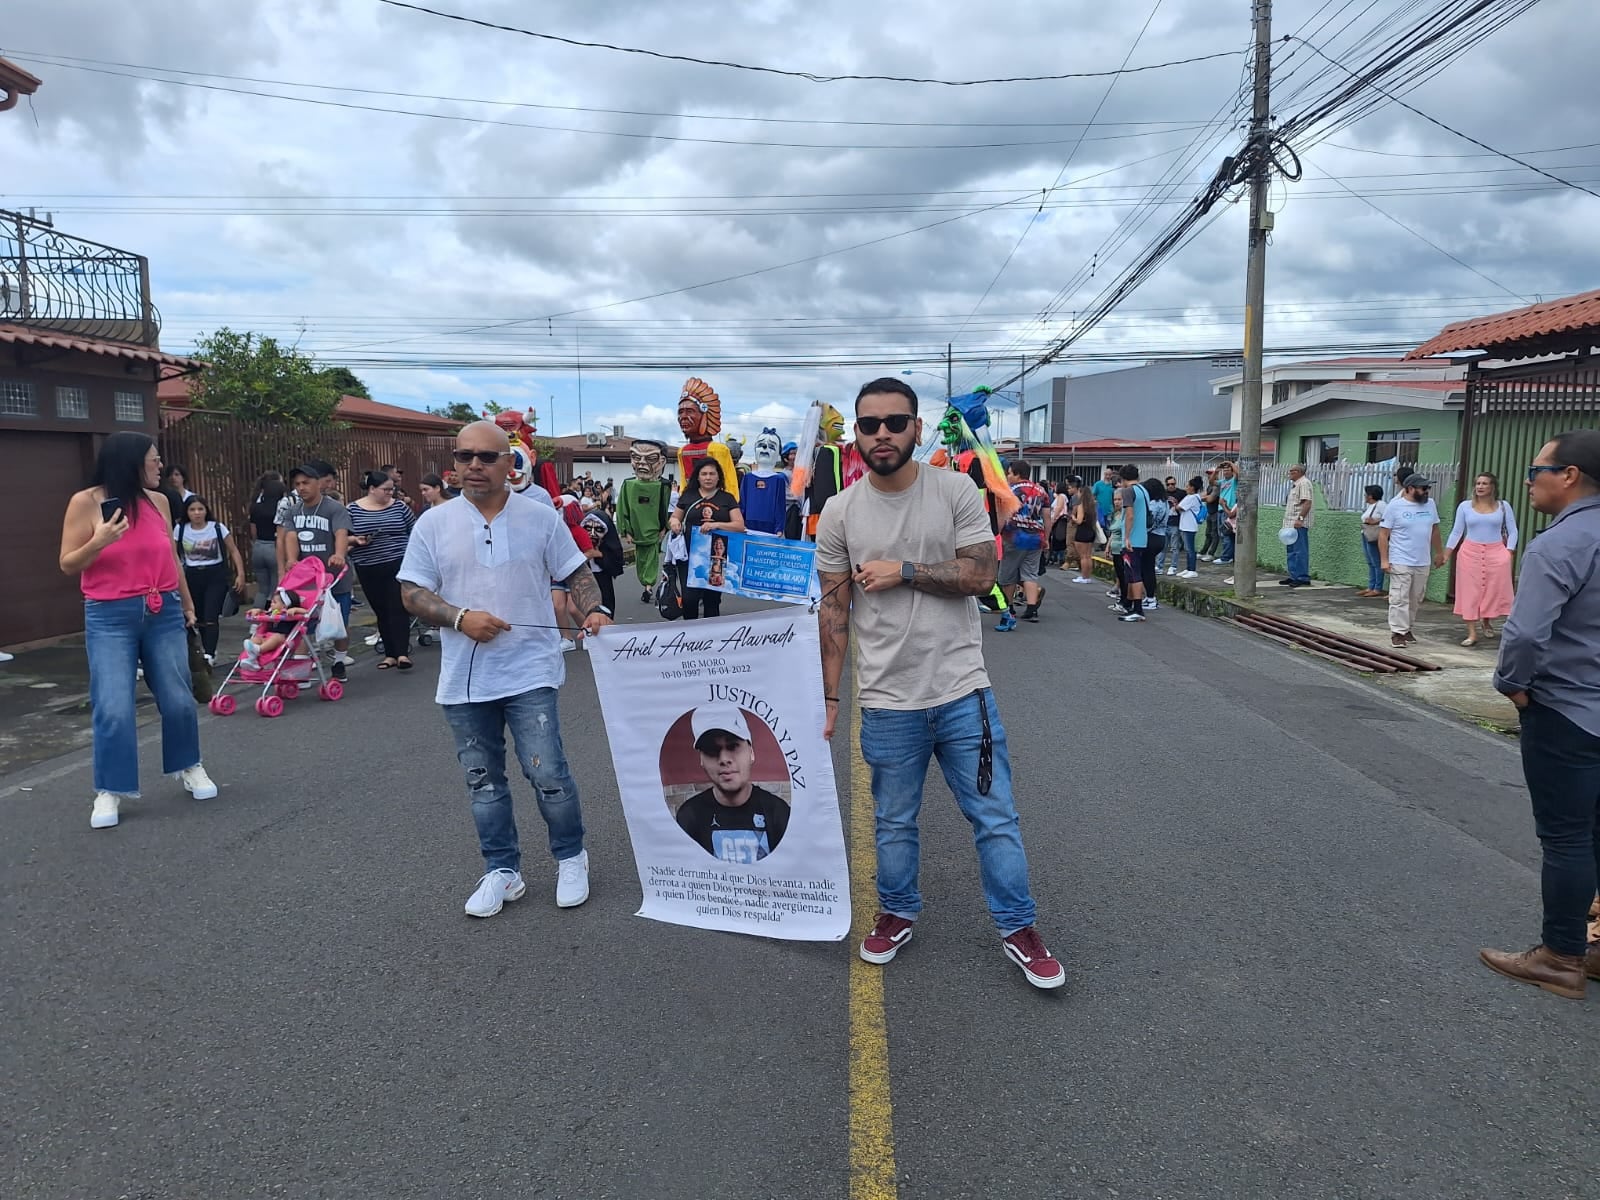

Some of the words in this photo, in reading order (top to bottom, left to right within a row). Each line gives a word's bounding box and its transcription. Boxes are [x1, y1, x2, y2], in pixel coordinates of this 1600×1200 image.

[613, 635, 657, 661] Ariel
[658, 631, 713, 658] Arauz
[661, 669, 701, 679] 10-10-1997
[707, 664, 752, 676] 16-04-2022
[681, 660, 697, 669] BIG
[699, 657, 726, 668] MORO
[708, 684, 779, 732] JUSTICIA
[779, 728, 792, 743] Y
[785, 748, 806, 790] PAZ
[649, 876, 680, 888] derrota
[688, 881, 711, 893] quien
[713, 881, 732, 893] Dios
[773, 889, 798, 900] nadie
[800, 891, 838, 903] maldice
[678, 867, 718, 880] derrumba
[720, 871, 727, 882] al
[729, 874, 745, 886] que
[747, 874, 767, 886] Dios
[809, 878, 836, 890] nadie
[655, 889, 660, 897] a
[662, 889, 685, 901] quien
[687, 890, 706, 902] Dios
[744, 897, 769, 908] nadie
[772, 900, 824, 914] avergüenza
[826, 907, 832, 915] a
[696, 904, 720, 916] quien
[722, 905, 742, 918] Dios
